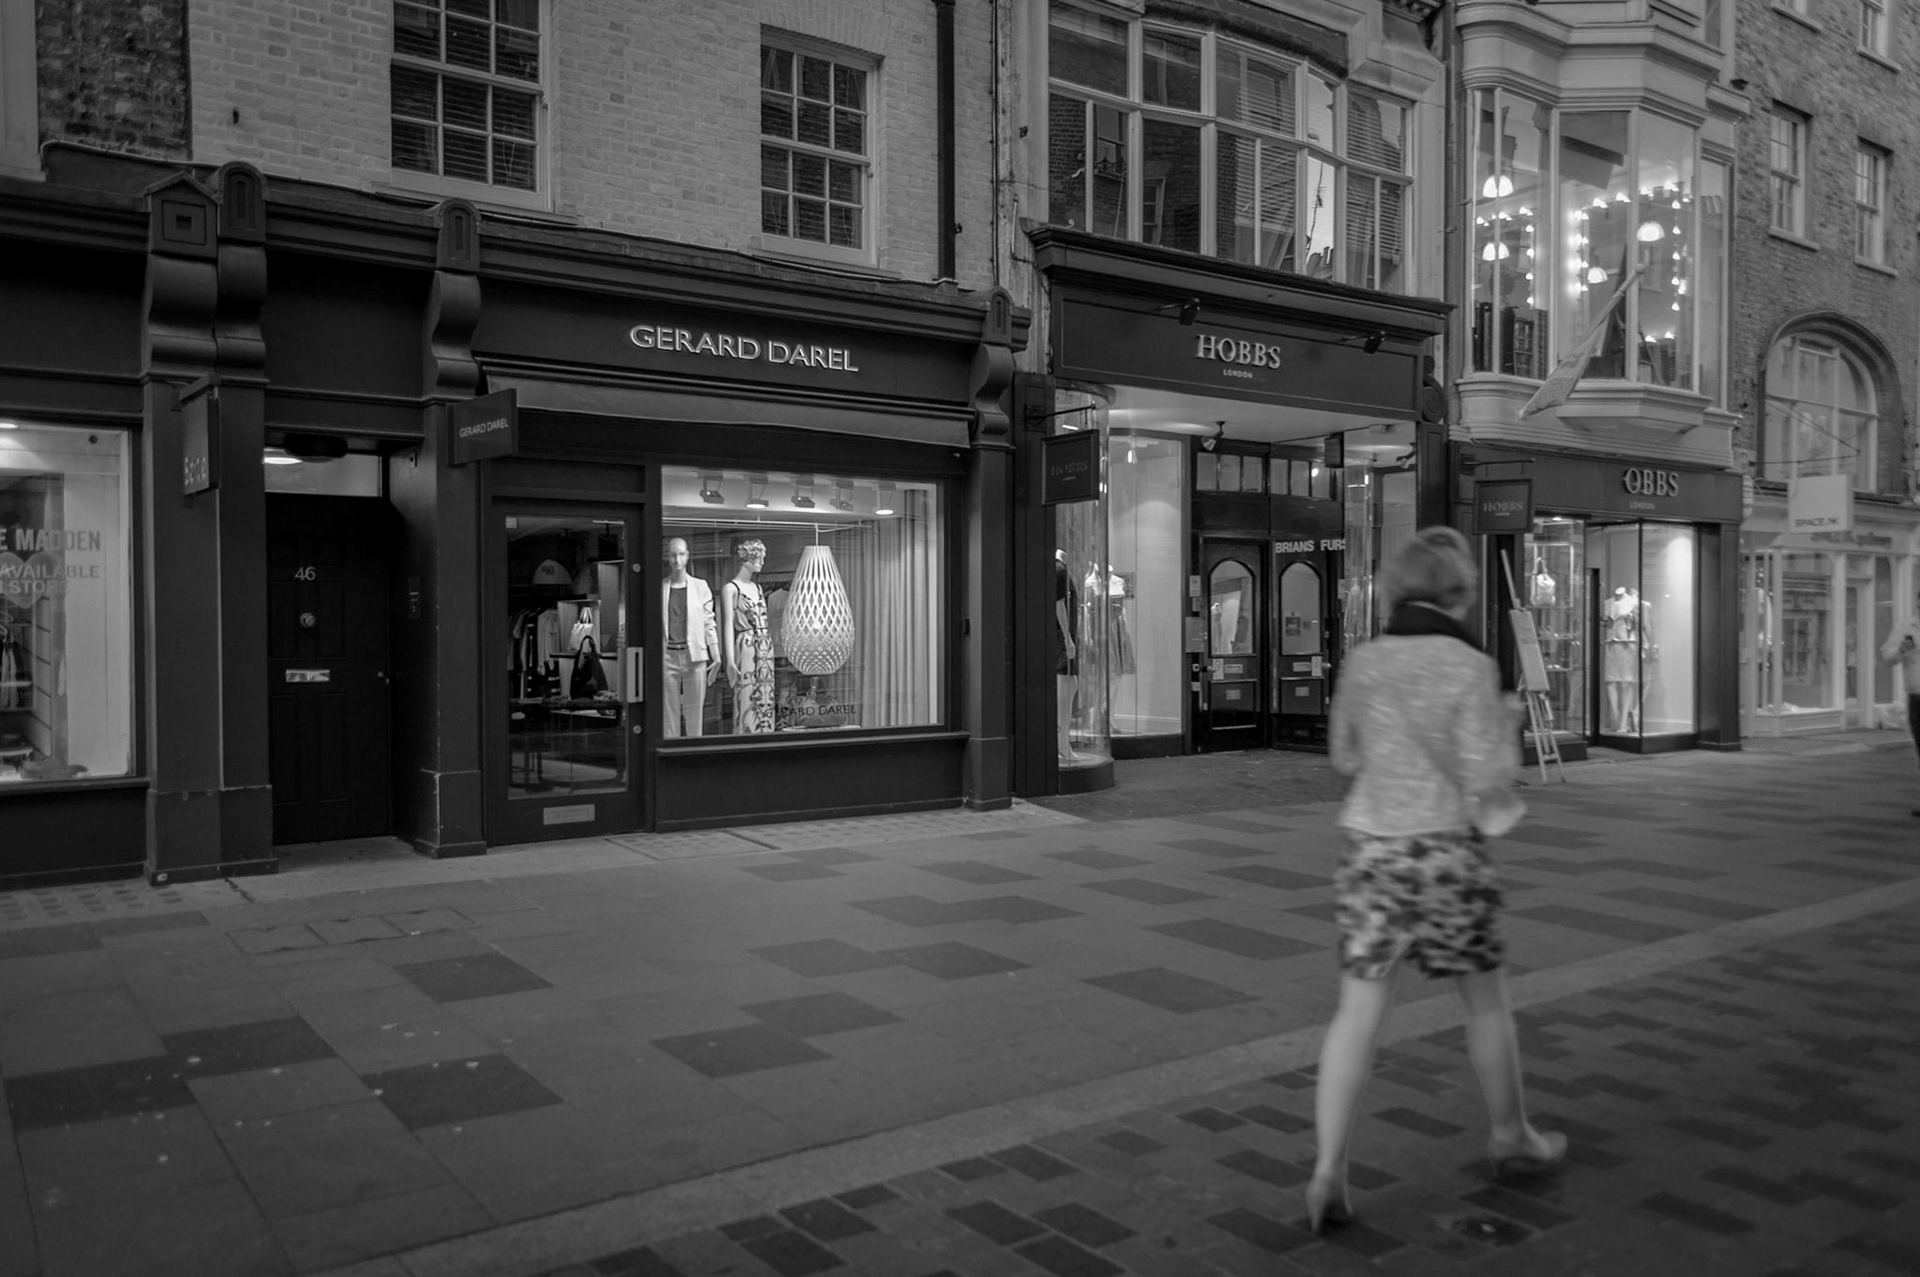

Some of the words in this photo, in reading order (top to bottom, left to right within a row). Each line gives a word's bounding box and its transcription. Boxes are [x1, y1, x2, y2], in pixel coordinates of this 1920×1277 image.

[629, 324, 761, 360] GERARD
[768, 340, 859, 372] DAREL
[1196, 334, 1281, 369] HOBBS
[1222, 368, 1254, 379] LONDON
[459, 423, 487, 438] GERARD
[486, 418, 510, 432] DAREL
[1623, 467, 1679, 497] OBBS
[15, 528, 101, 551] MADDEN
[1275, 539, 1315, 554] BRIANS
[0, 564, 100, 579] AVAILABLE
[294, 566, 316, 581] 46
[818, 704, 856, 716] DAREL
